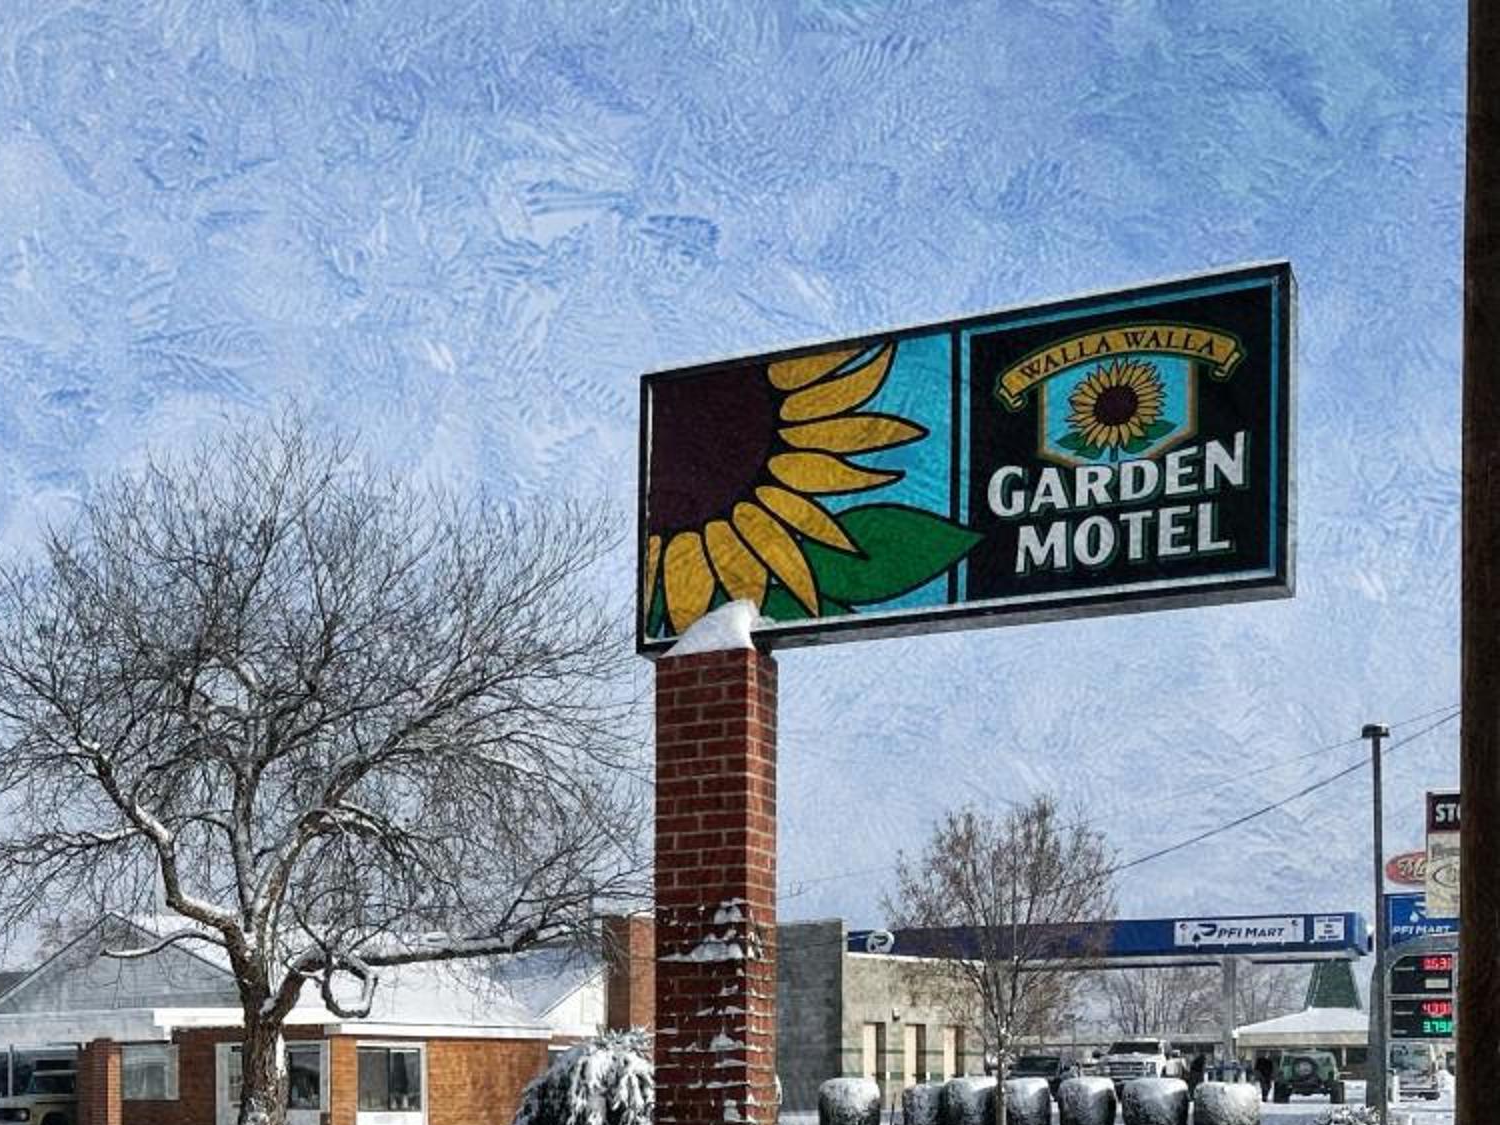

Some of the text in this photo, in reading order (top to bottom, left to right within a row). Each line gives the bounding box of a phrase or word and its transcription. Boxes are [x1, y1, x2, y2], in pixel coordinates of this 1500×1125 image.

[1019, 331, 1215, 379] WALLA WALLA
[987, 431, 1246, 517] GARDEN
[1015, 502, 1231, 573] MOTEL
[1245, 927, 1285, 938] MART
[1415, 925, 1451, 934] MART
